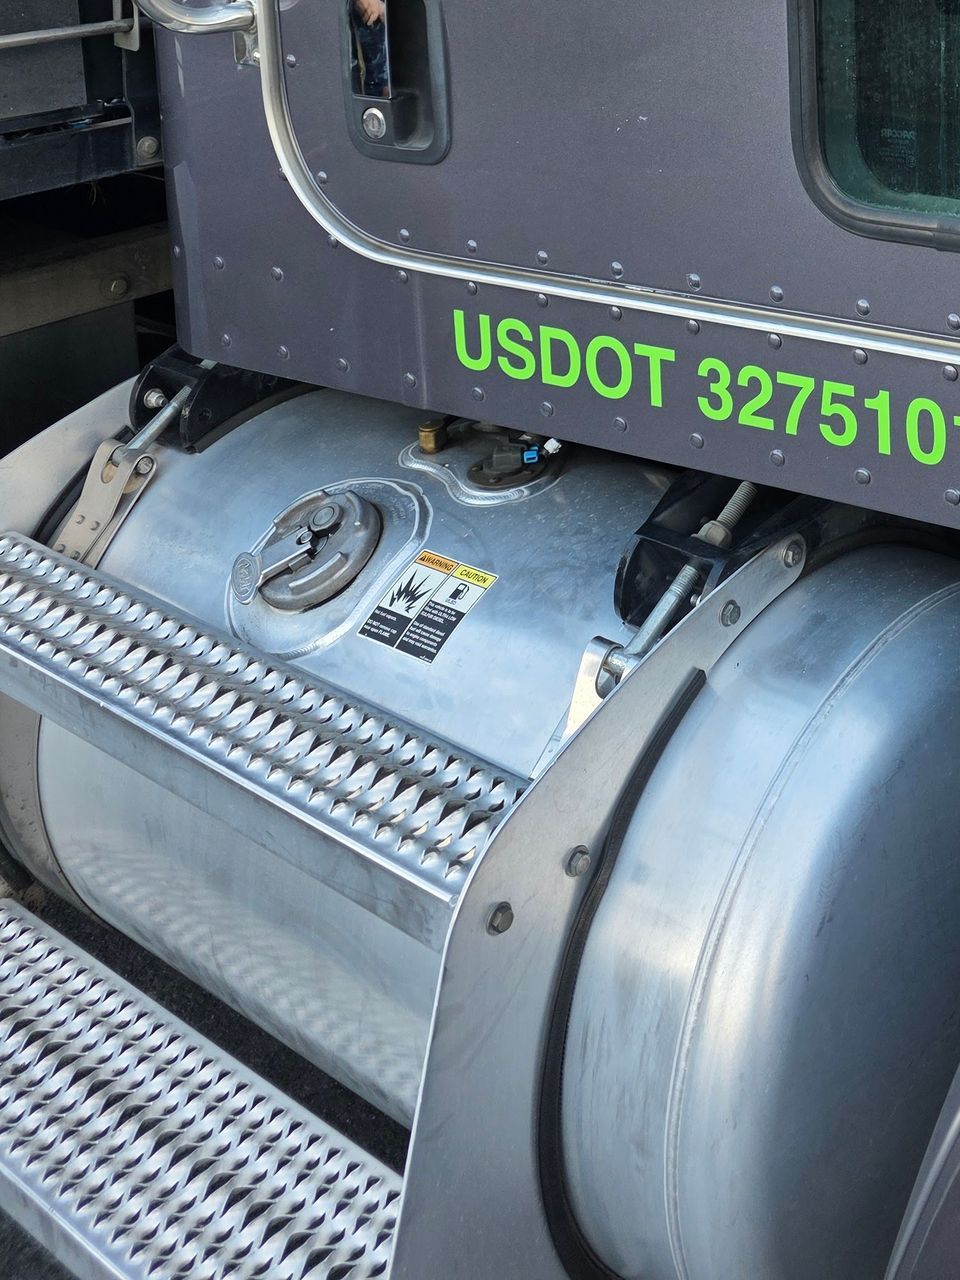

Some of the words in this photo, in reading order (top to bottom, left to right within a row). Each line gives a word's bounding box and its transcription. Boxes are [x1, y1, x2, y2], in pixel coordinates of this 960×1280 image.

[453, 309, 676, 408] USDOT
[424, 554, 454, 571] WARNING
[459, 569, 488, 584] CAUTION
